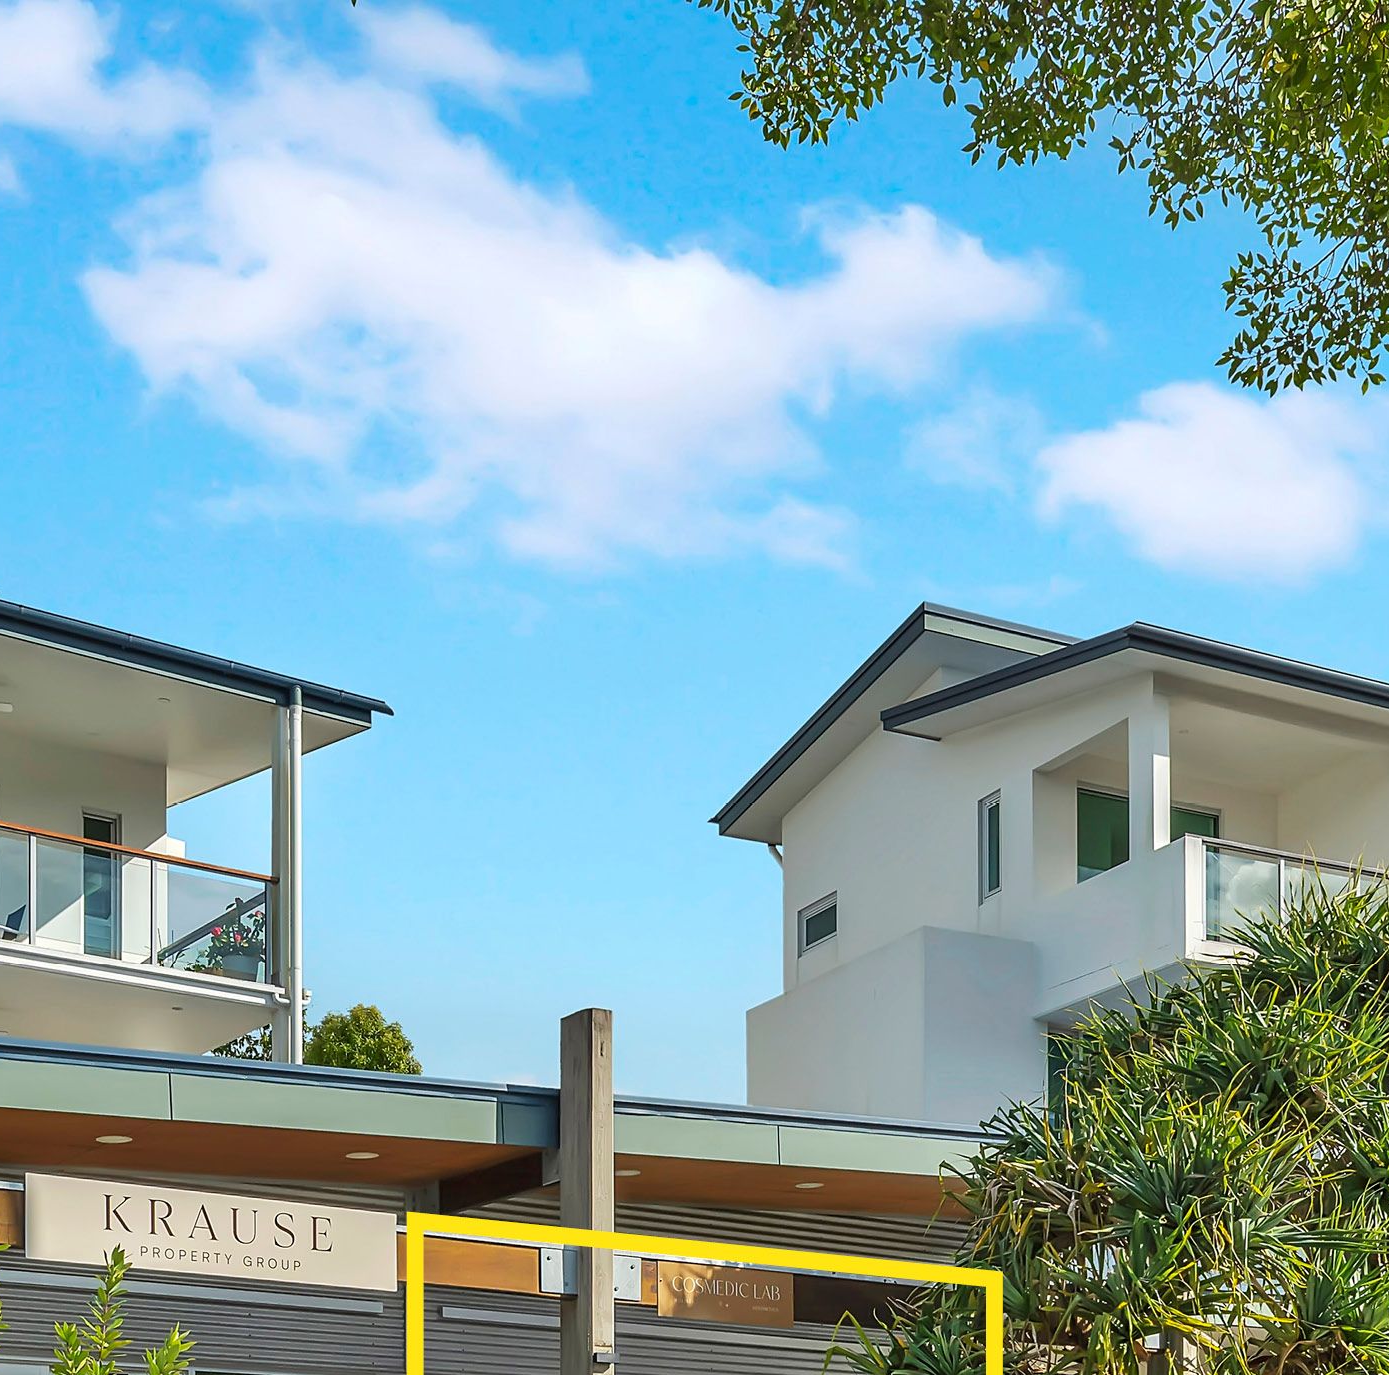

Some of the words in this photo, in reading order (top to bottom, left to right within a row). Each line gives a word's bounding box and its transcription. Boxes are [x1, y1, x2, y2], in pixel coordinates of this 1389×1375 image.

[102, 1193, 334, 1253] KRAUSE
[140, 1245, 233, 1265] PROPERTY
[243, 1255, 302, 1272] GROUP
[672, 1275, 749, 1299] COSMEDIC
[753, 1283, 781, 1301] LAB
